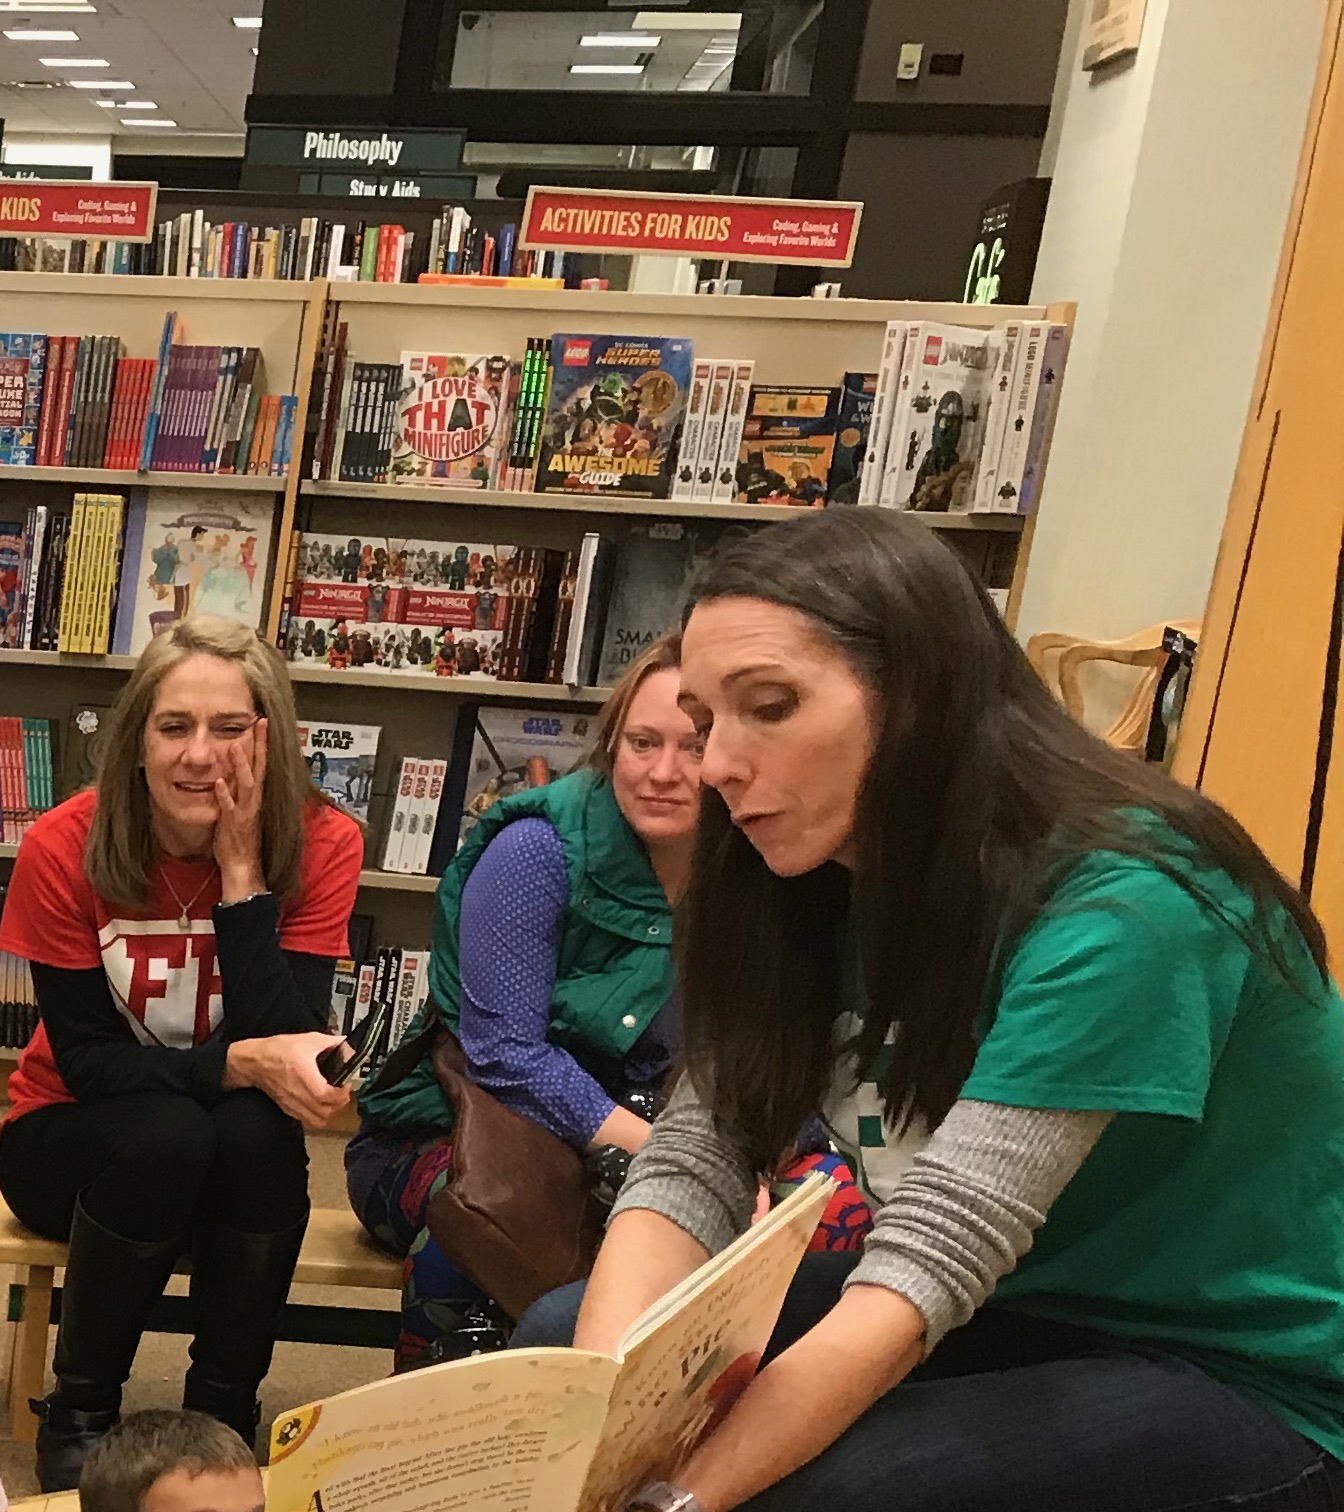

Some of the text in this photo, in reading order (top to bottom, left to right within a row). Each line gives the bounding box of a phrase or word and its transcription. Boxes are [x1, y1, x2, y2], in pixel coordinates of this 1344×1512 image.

[303, 131, 404, 166] Philosophy
[391, 180, 421, 198] Aids
[0, 197, 41, 222] KIDS
[53, 210, 84, 225] Exploring
[111, 213, 136, 225] Worlds
[540, 206, 732, 242] ACTIVITIES FOR KIDS
[772, 218, 839, 235] Coding, Gaming &
[743, 231, 837, 248] Exploring Favorite Worlds
[565, 348, 590, 358] LEGO
[605, 347, 661, 357] SUPER
[1026, 341, 1039, 361] LEGO
[595, 354, 662, 366] HEROES
[417, 378, 478, 403] I LOVE
[401, 397, 491, 432] THAT
[403, 425, 489, 460] MINIFIGURE
[547, 453, 663, 476] AWESOME
[579, 470, 622, 487] GUIDE
[319, 588, 363, 602] NINJAGO
[425, 595, 471, 609] NINJAGO
[615, 628, 663, 645] SMA
[315, 728, 353, 740] STAR
[311, 736, 354, 750] WARS
[389, 956, 398, 980] STAR
